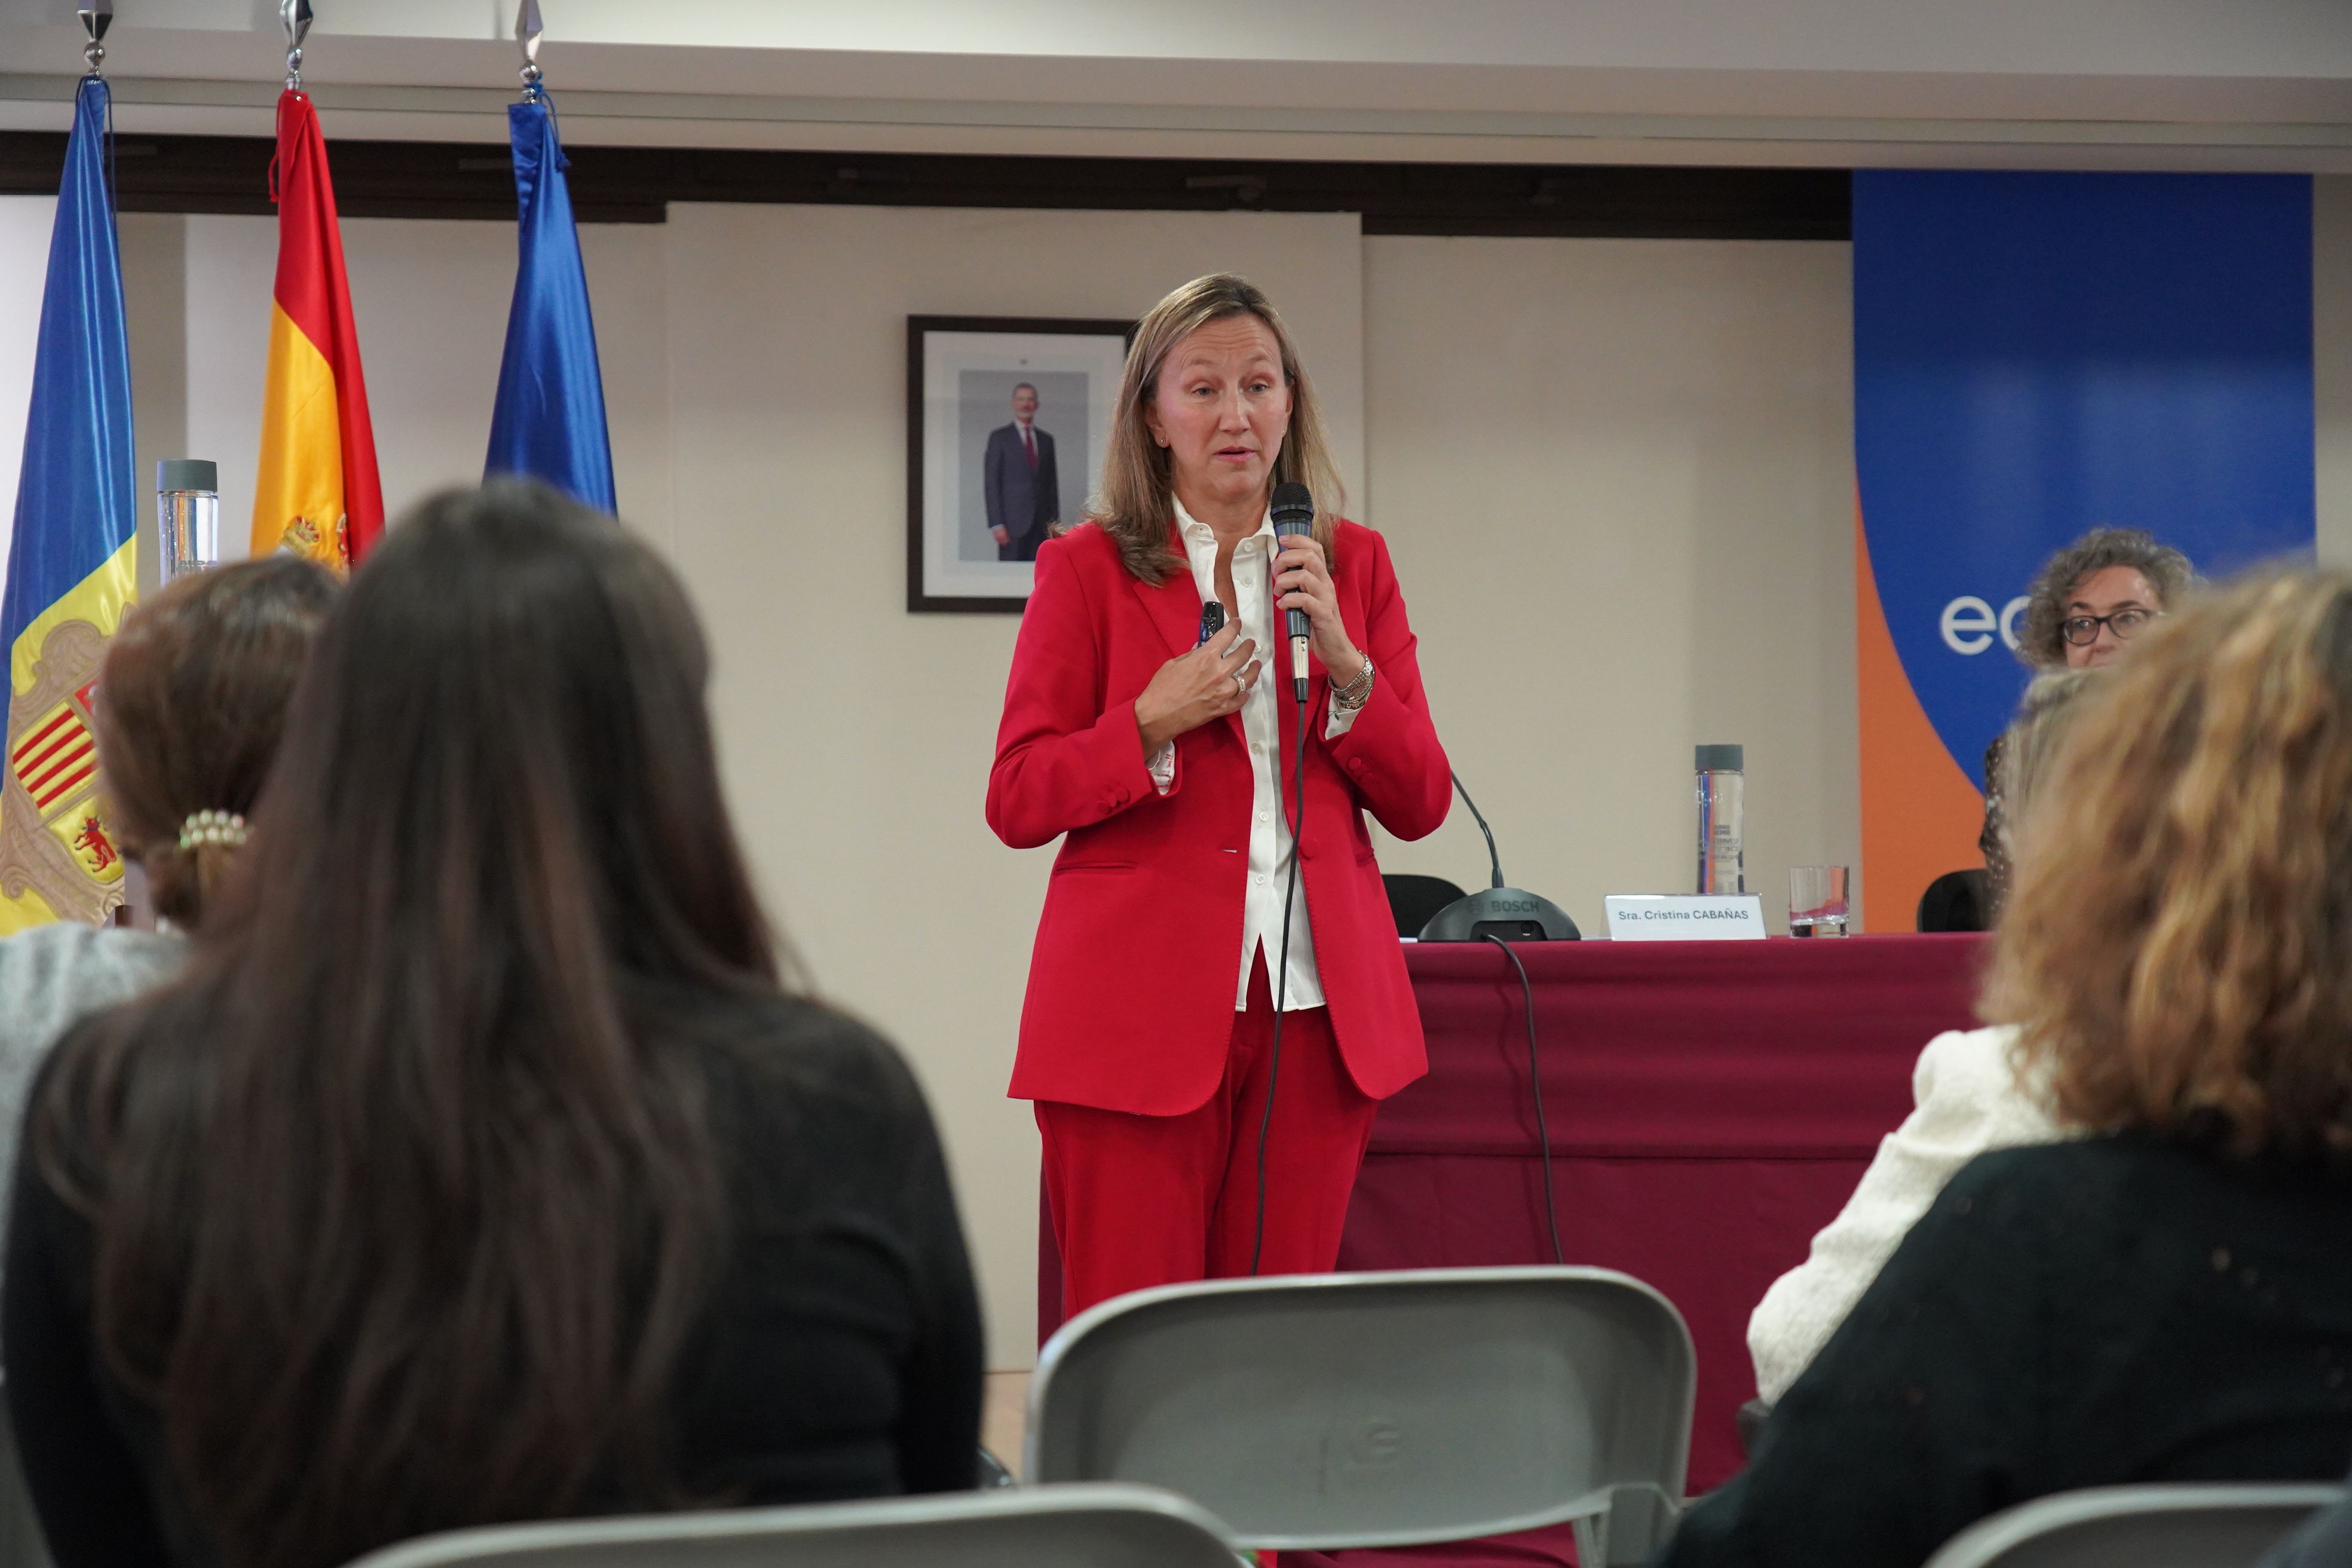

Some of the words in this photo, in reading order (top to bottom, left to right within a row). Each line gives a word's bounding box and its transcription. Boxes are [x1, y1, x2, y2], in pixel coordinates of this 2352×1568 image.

[1492, 901, 1539, 912] BOSCH
[1618, 911, 1642, 920] Sra.
[1644, 910, 1690, 920] Cristina
[1693, 908, 1748, 919] CABAÑAS
